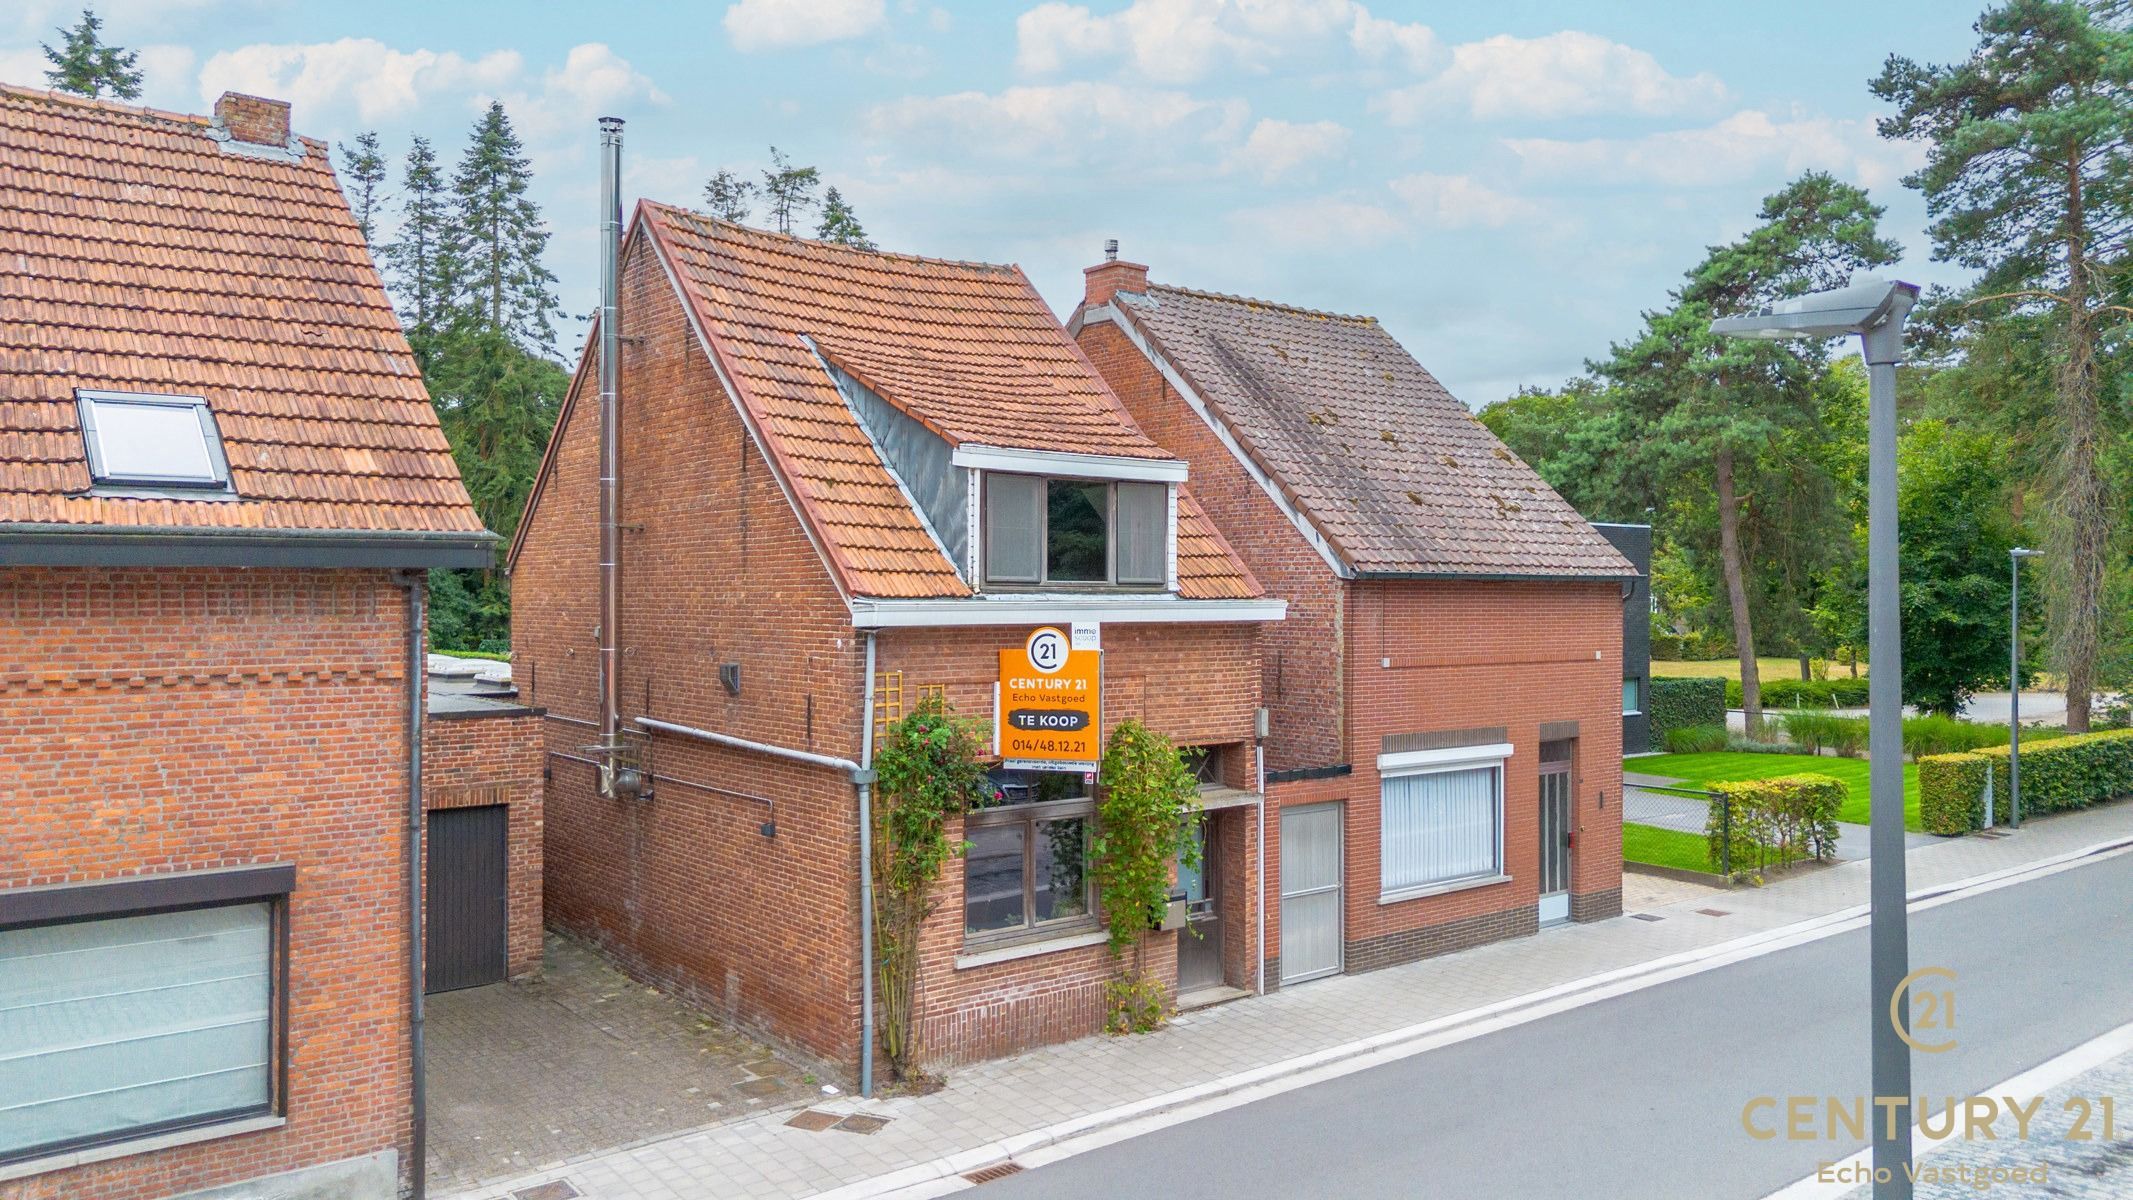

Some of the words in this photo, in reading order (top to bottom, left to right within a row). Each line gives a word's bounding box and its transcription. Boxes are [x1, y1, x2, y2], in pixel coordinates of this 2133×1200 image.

[1009, 678, 1071, 690] CENTURY
[1075, 679, 1088, 690] 21
[1012, 693, 1036, 703] Echo
[1039, 693, 1086, 704] Vastgoed
[1018, 715, 1035, 726] TE
[1039, 715, 1079, 727] KOOP
[1012, 739, 1086, 752] 014/48.12.21
